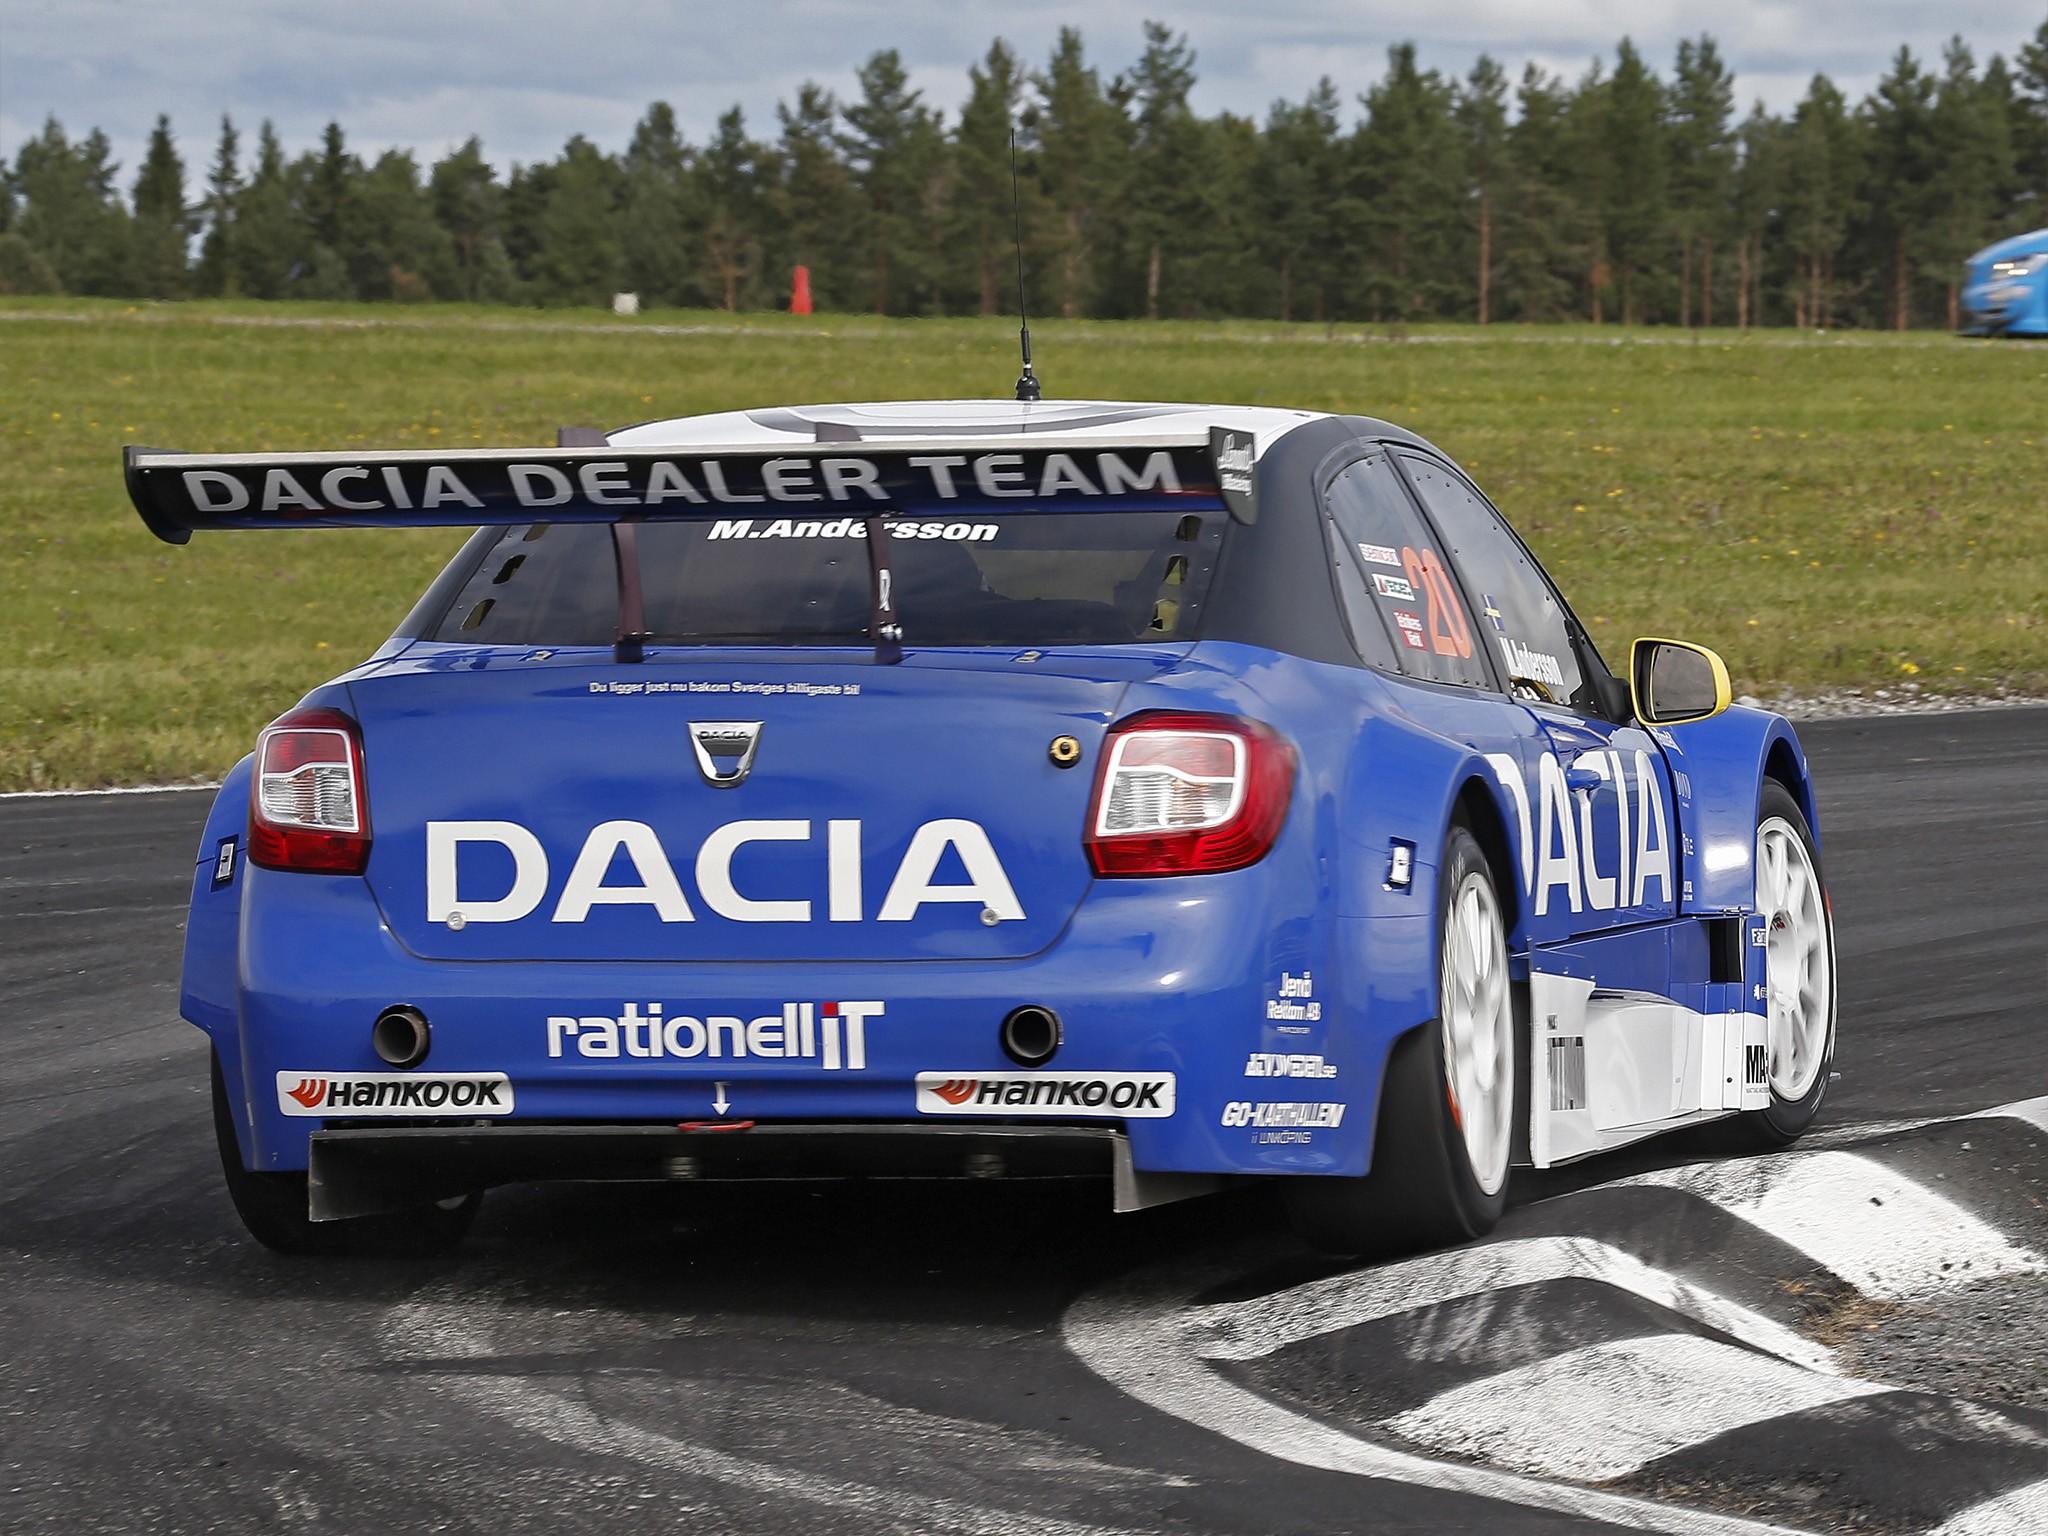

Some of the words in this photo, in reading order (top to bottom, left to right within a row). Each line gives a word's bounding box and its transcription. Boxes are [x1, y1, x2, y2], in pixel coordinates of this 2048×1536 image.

[185, 467, 484, 514] DACIA
[511, 456, 891, 507] DEALER
[910, 452, 1180, 501] TEAM
[1402, 546, 1472, 660] 20
[589, 682, 607, 692] Du
[609, 682, 643, 694] ligger
[645, 682, 670, 694] just
[671, 683, 687, 692] nu
[689, 682, 730, 693] bakom
[732, 682, 785, 695] Sveriges
[787, 683, 842, 696] billigaste
[843, 685, 860, 696] bil
[699, 730, 751, 741] DACIA
[425, 819, 1025, 925] DACIA
